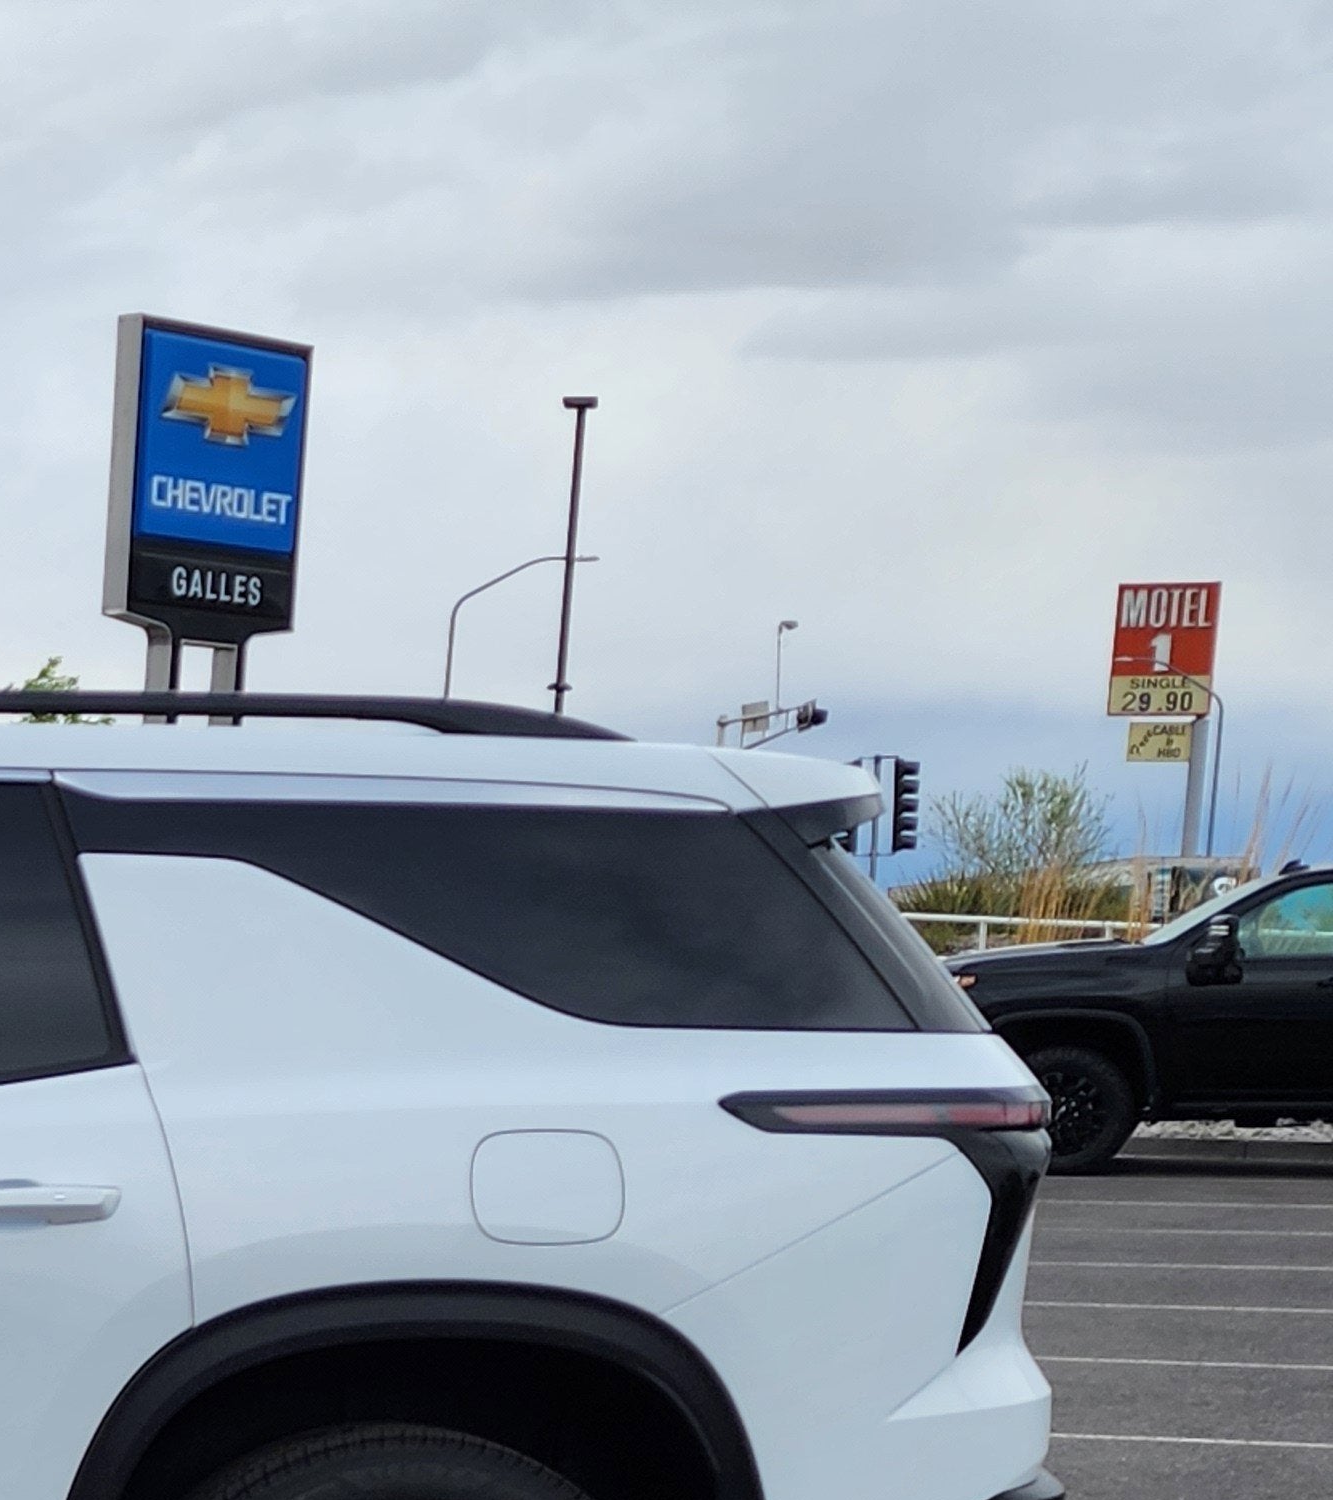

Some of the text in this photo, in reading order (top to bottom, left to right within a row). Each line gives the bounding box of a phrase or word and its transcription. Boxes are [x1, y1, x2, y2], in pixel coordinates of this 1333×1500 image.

[150, 474, 293, 525] CHEVROLET
[172, 566, 262, 606] GALLES
[1120, 587, 1213, 628] MOTEL
[1149, 632, 1172, 672] 1
[1120, 690, 1194, 713] 29.90
[1129, 677, 1192, 690] SINGLE
